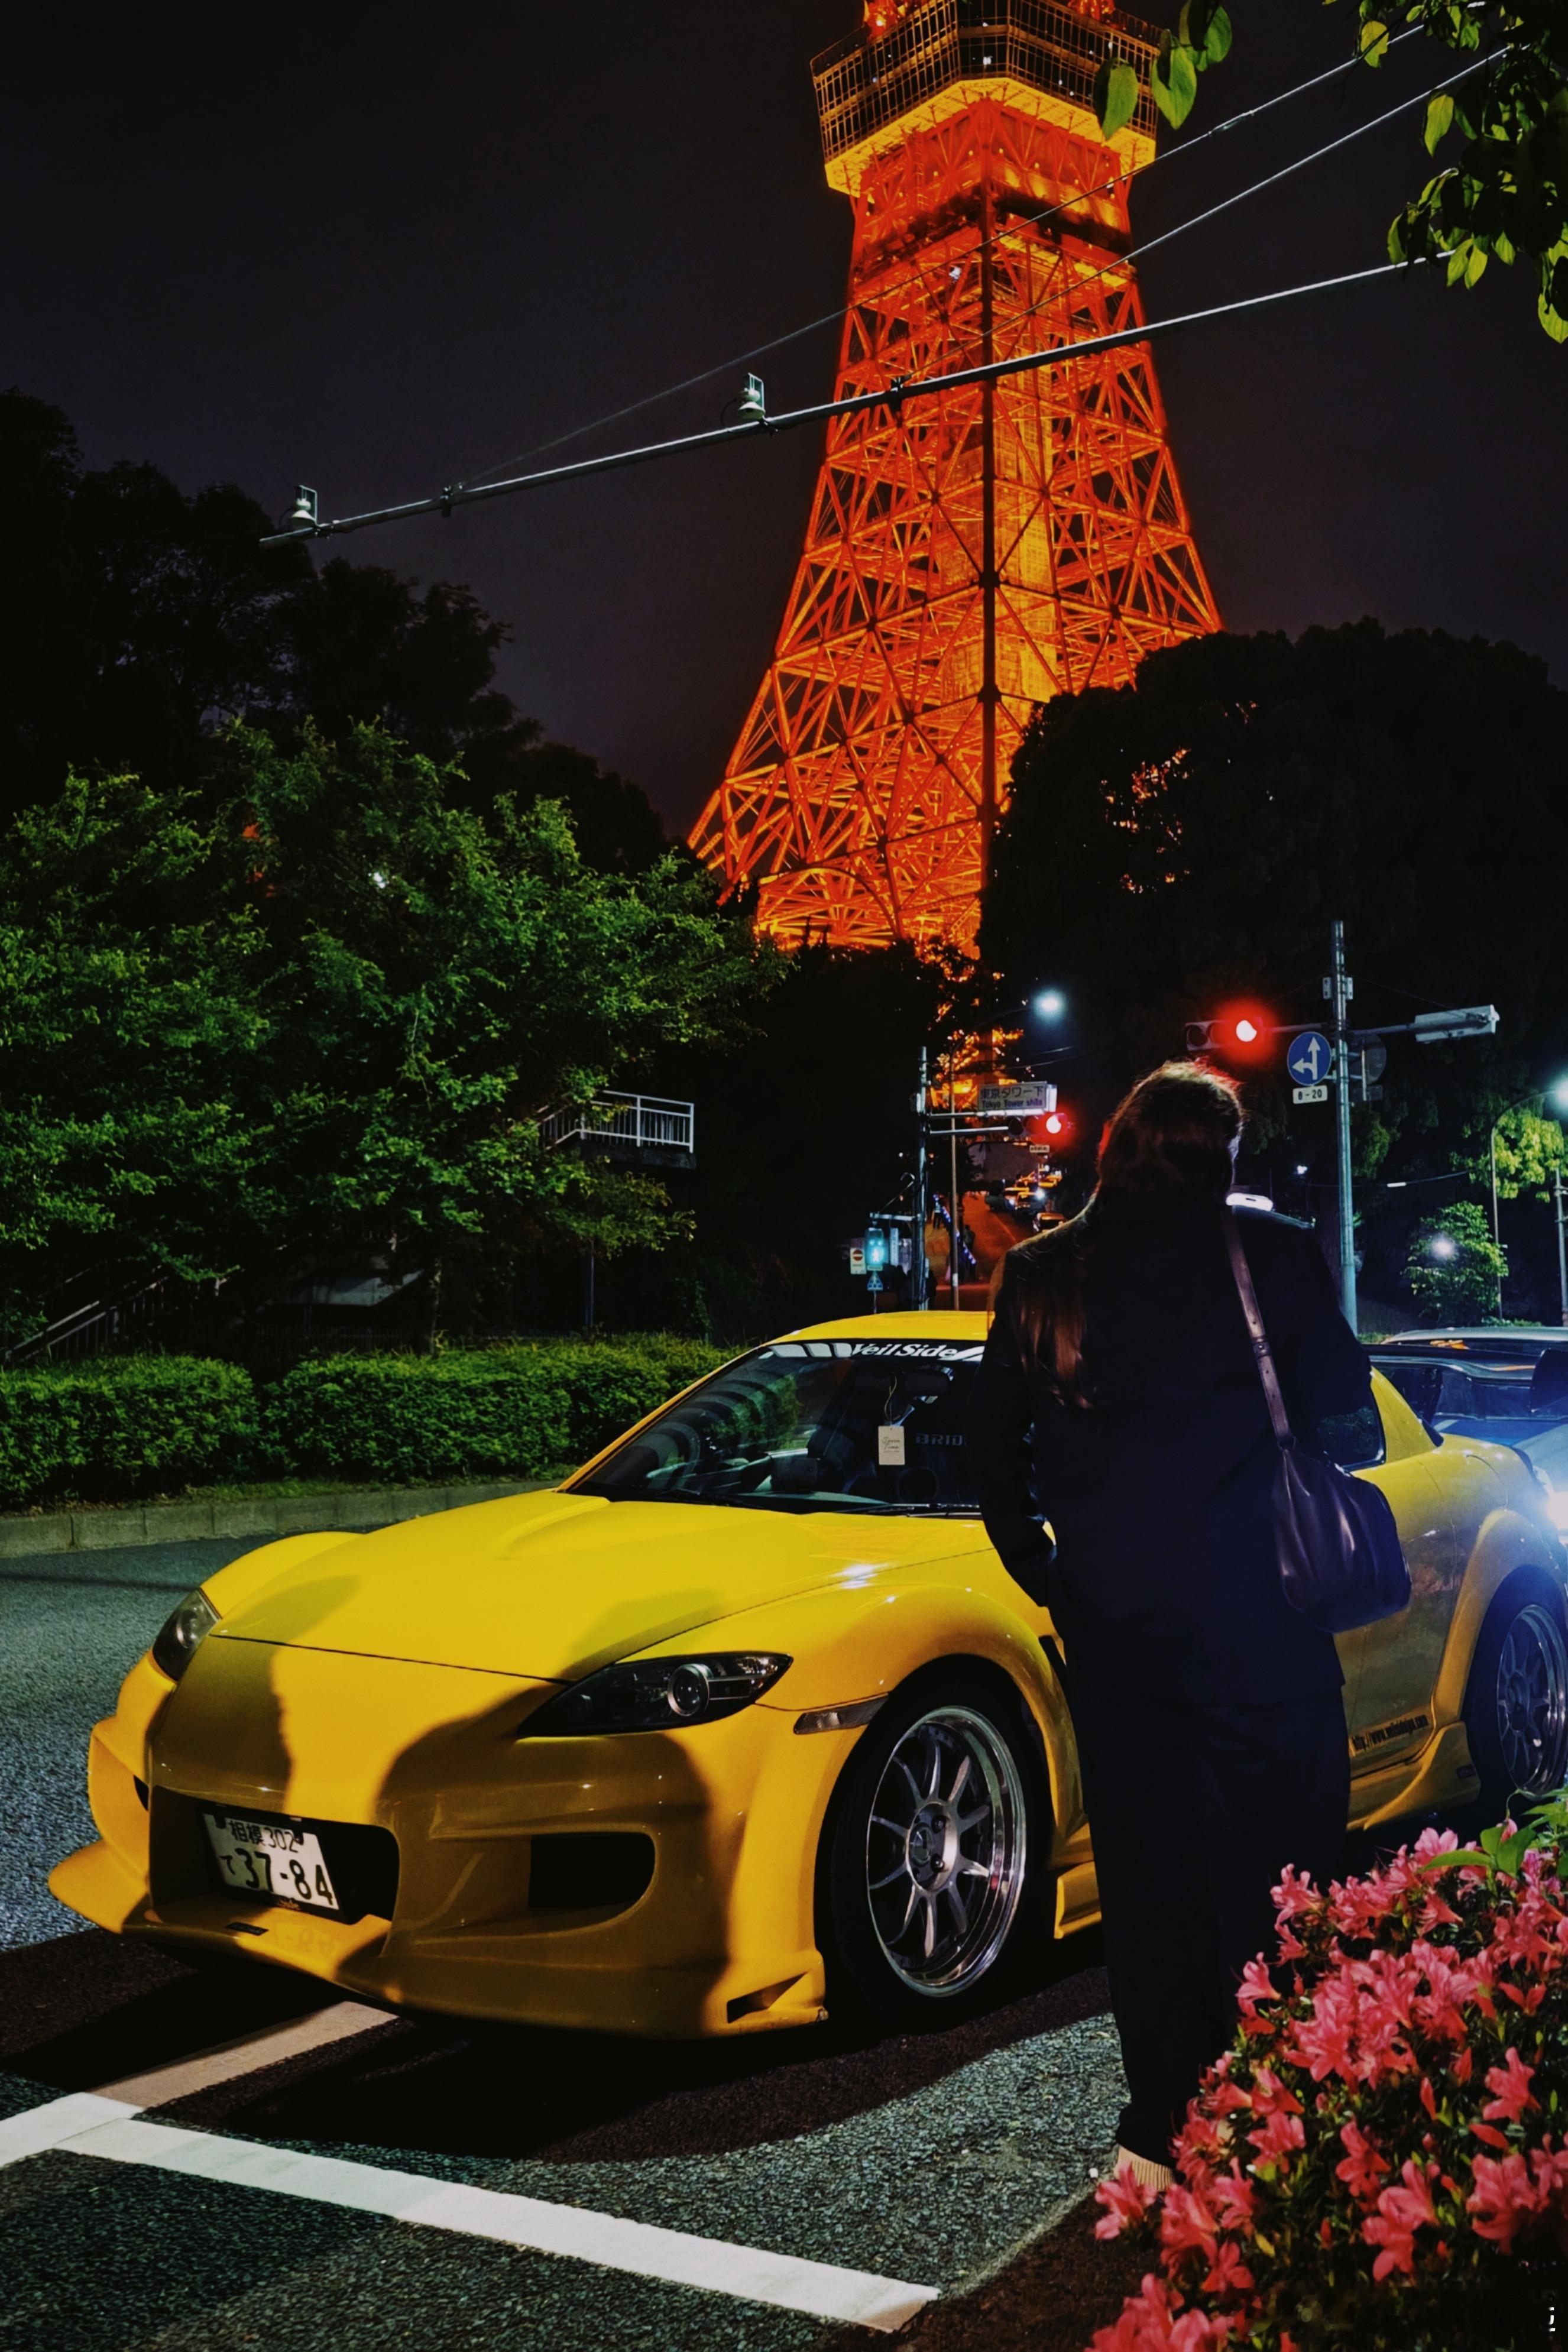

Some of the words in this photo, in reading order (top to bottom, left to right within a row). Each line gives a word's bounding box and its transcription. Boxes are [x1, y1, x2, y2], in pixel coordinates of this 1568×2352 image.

[980, 1086, 1043, 1099] 東京タワー下
[983, 1100, 1001, 1110] Tokyo
[1005, 1099, 1023, 1107] Tower
[916, 1433, 966, 1446] BRID
